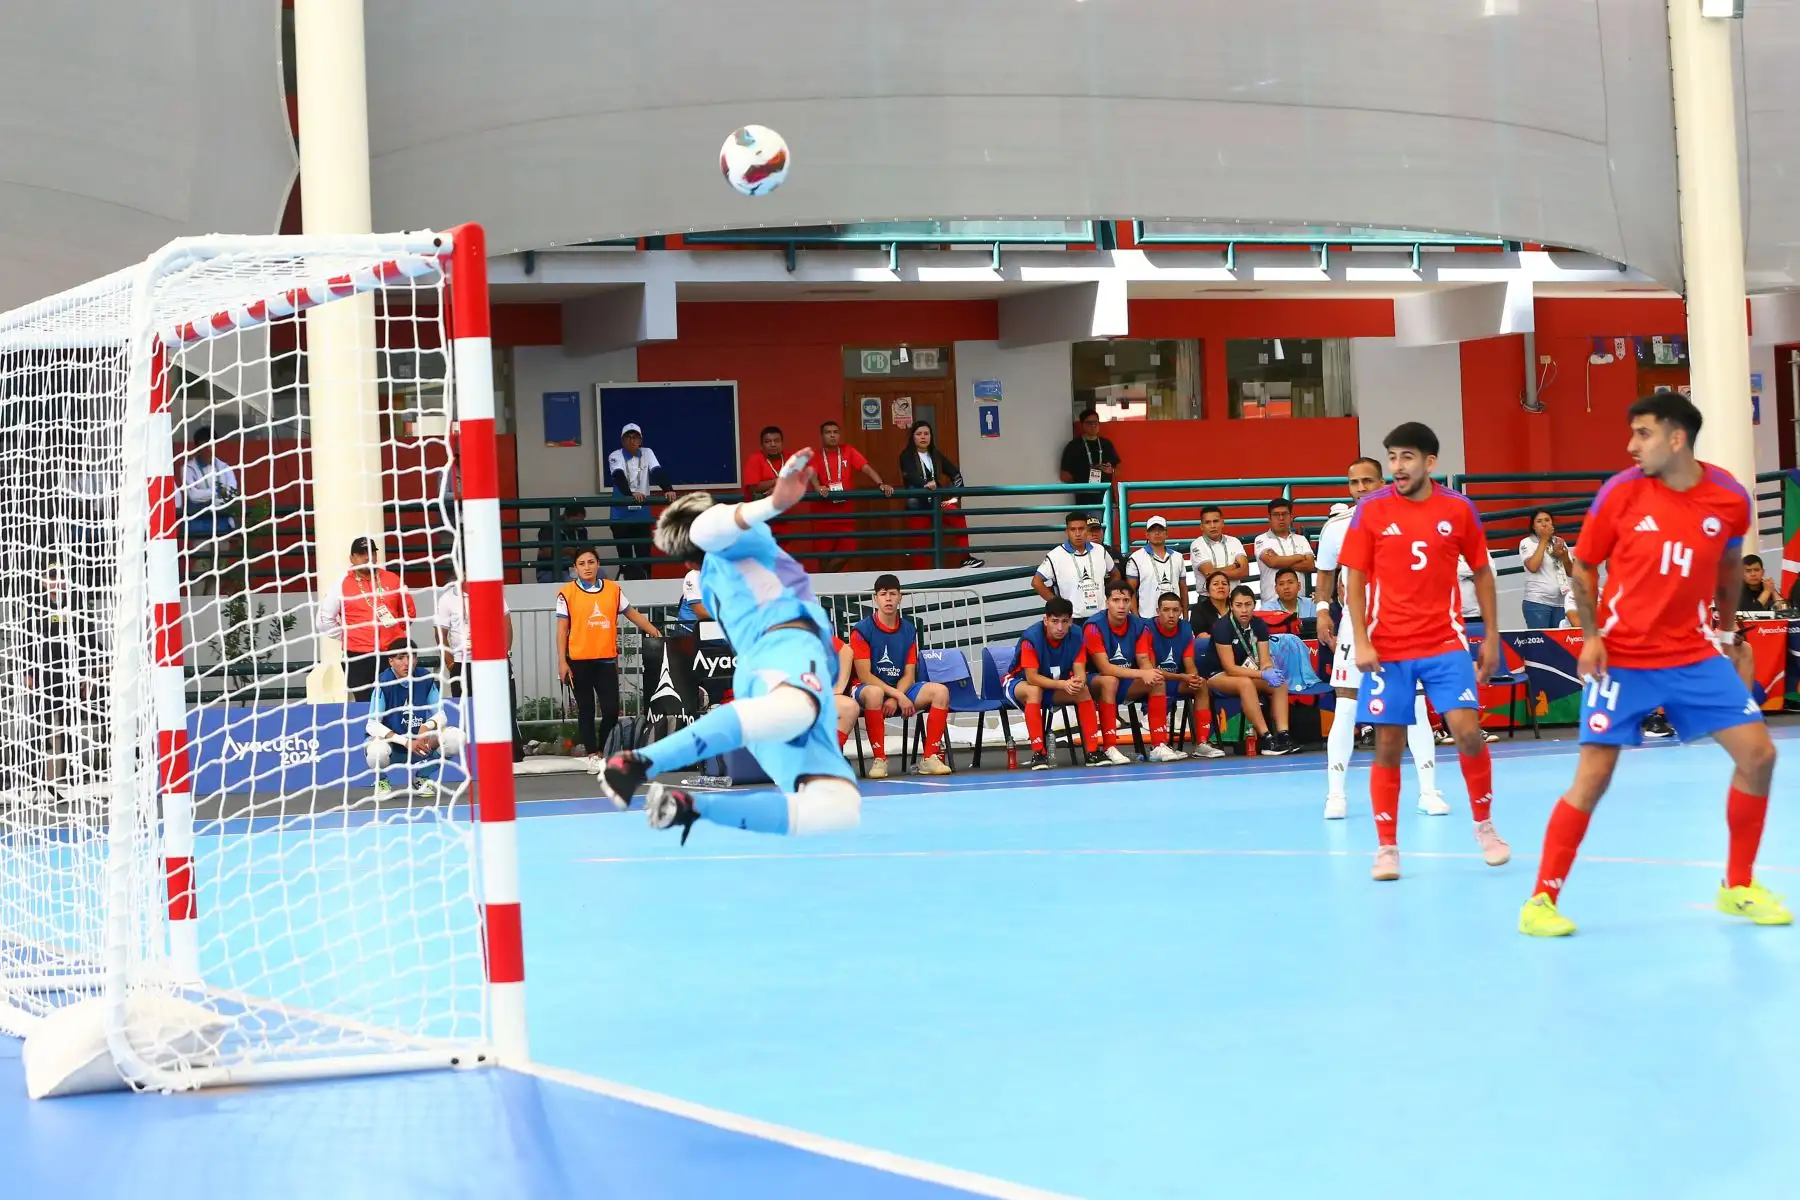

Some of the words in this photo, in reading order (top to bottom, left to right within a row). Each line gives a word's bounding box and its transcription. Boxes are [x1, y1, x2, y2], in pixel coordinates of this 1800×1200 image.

[1411, 541, 1428, 571] 5
[1660, 540, 1694, 577] 14
[1341, 644, 1351, 660] 4
[1371, 666, 1386, 696] 5
[221, 733, 320, 761] Ayacucho
[280, 750, 320, 764] 2024
